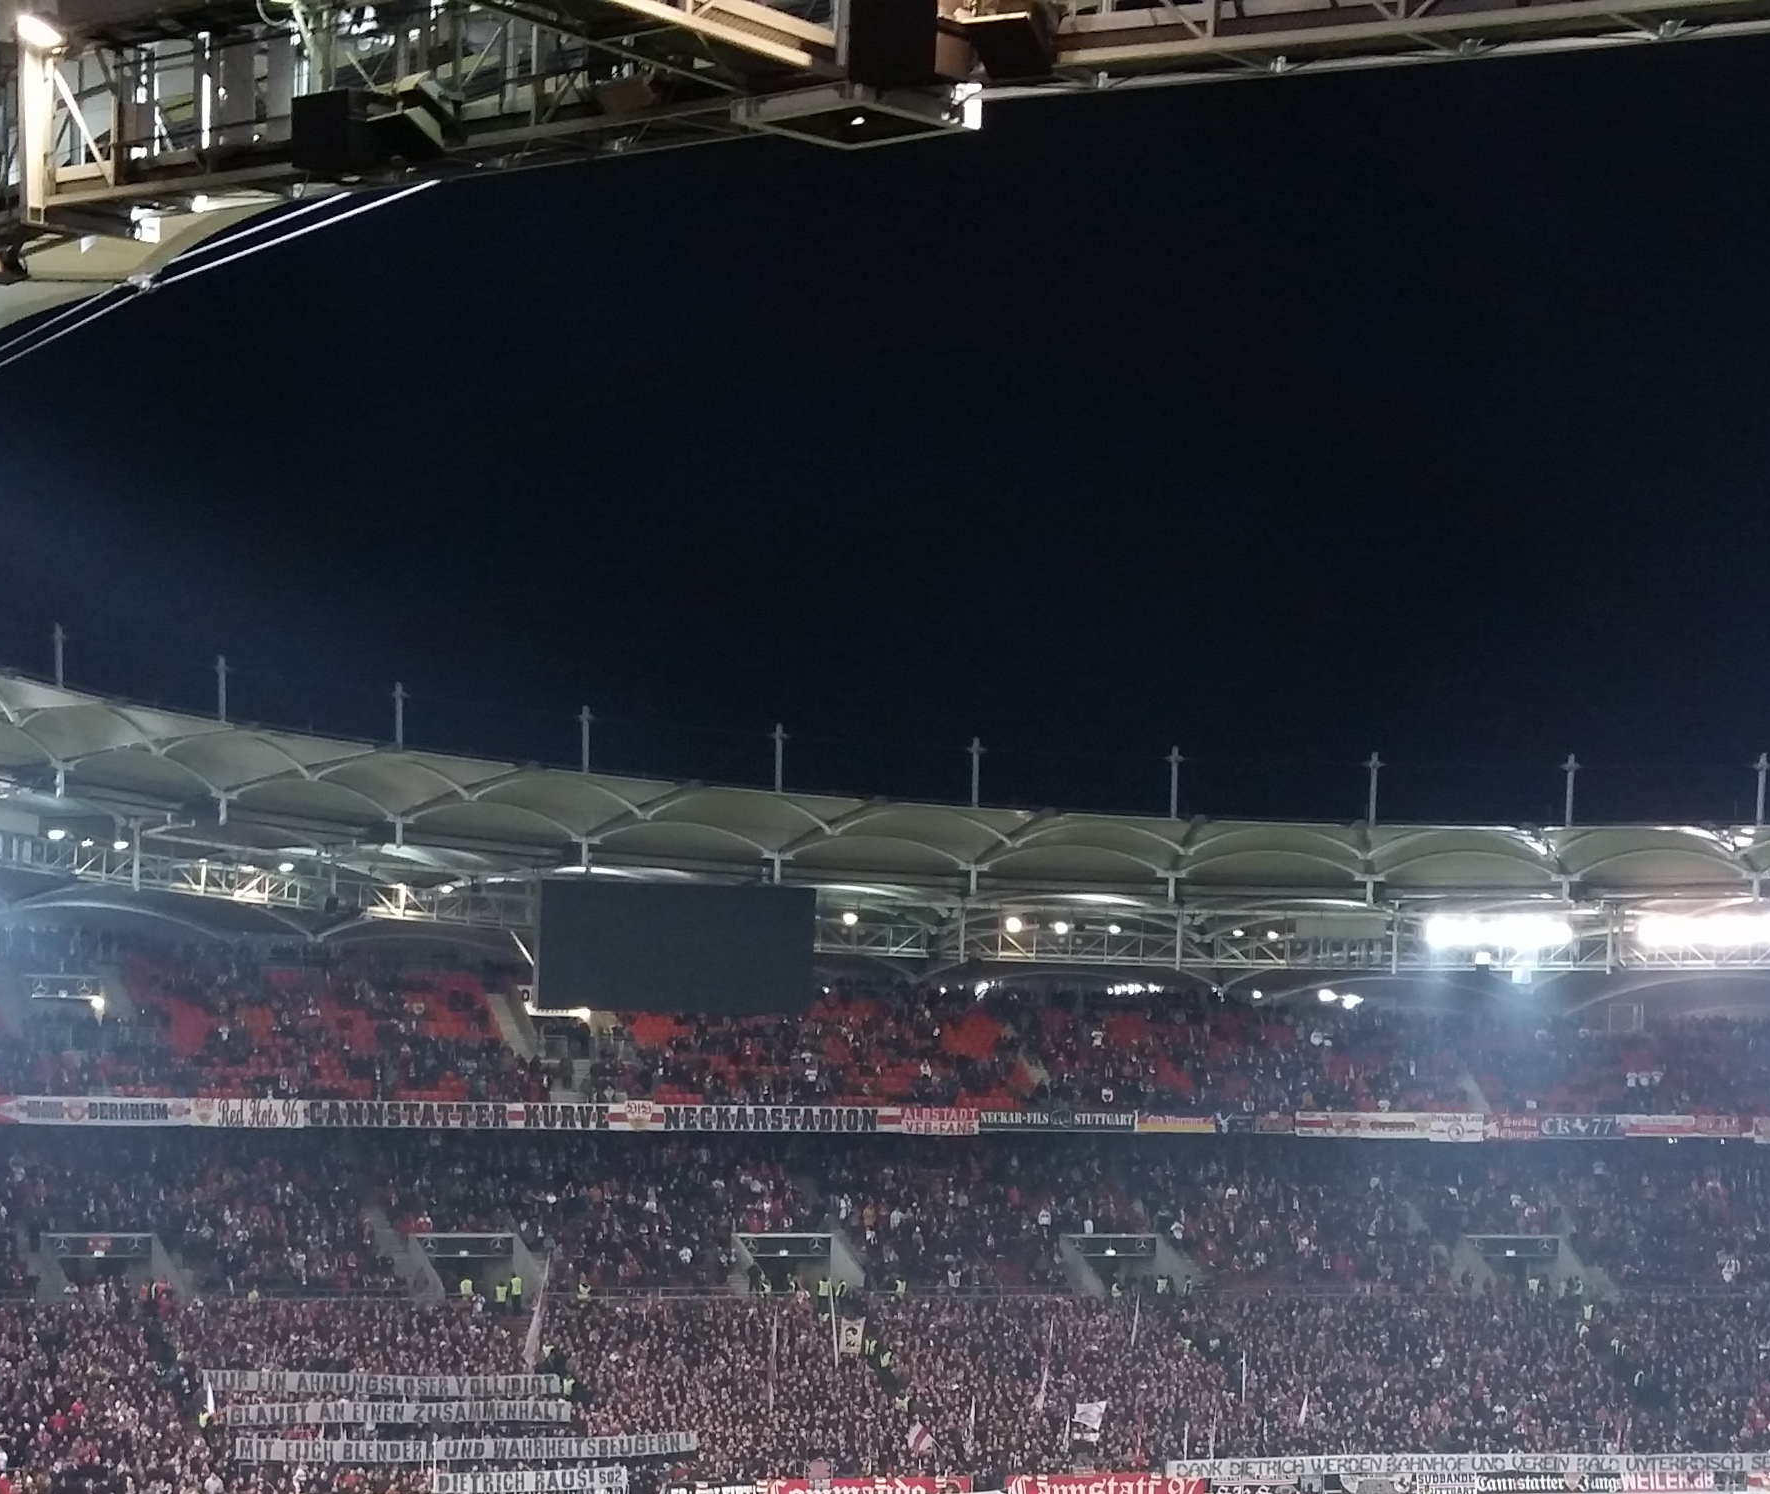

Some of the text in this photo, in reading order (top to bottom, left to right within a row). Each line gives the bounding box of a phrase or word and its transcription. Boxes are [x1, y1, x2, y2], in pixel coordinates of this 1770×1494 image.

[88, 1103, 168, 1120] BERKHEIM
[217, 1101, 245, 1126] Red
[281, 1100, 298, 1126] 96
[309, 1102, 878, 1132] CANNSTATTER KURVE NECKARSTADION
[980, 1111, 1049, 1125] NECKAR-FILS
[1074, 1112, 1134, 1125] STUTTGART
[1592, 1117, 1613, 1134] 77
[209, 1371, 555, 1396] NUR EIN AHNUNGSLOSER VOLLIDIOT
[230, 1400, 565, 1426] GLAUBT AN EINEN ZUSAMMENHALT
[239, 1438, 273, 1460] MIT
[284, 1440, 334, 1461] EUCH
[444, 1439, 485, 1458] UND
[493, 1432, 692, 1458] WAHRHEITSBEUGERN!
[1175, 1462, 1223, 1477] DANK
[1228, 1458, 1306, 1476] DIETRICH
[1310, 1455, 1383, 1473] WERDEN
[1386, 1454, 1469, 1472] BAHNHOF
[1471, 1455, 1505, 1471] UND
[1512, 1455, 1570, 1471] VEREIN
[1576, 1456, 1620, 1472] BALD
[1625, 1454, 1744, 1470] UNTERIRDISCH
[437, 1472, 525, 1493] DIETRICH
[533, 1469, 596, 1490] RAUS!
[1477, 1473, 1566, 1493] Cannstatter
